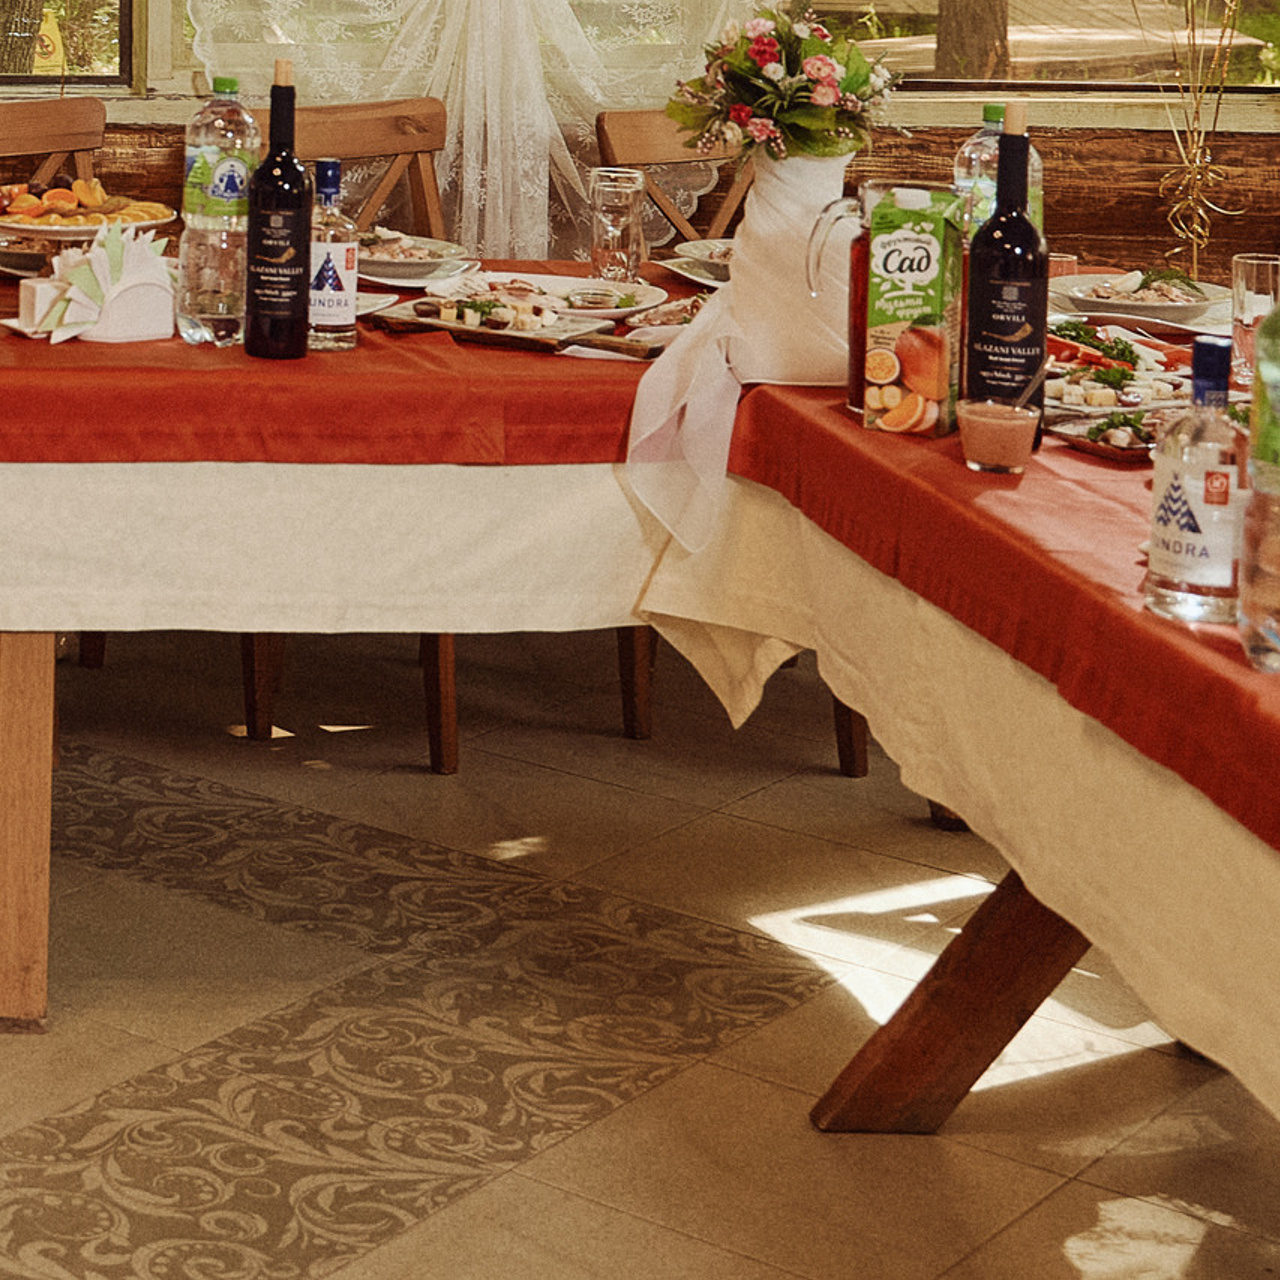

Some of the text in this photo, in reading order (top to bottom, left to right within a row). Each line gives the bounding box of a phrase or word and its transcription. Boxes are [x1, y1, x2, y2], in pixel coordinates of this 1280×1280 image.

[883, 246, 931, 274] Сад
[310, 298, 349, 308] UNDRA
[1157, 538, 1210, 559] NDRA
